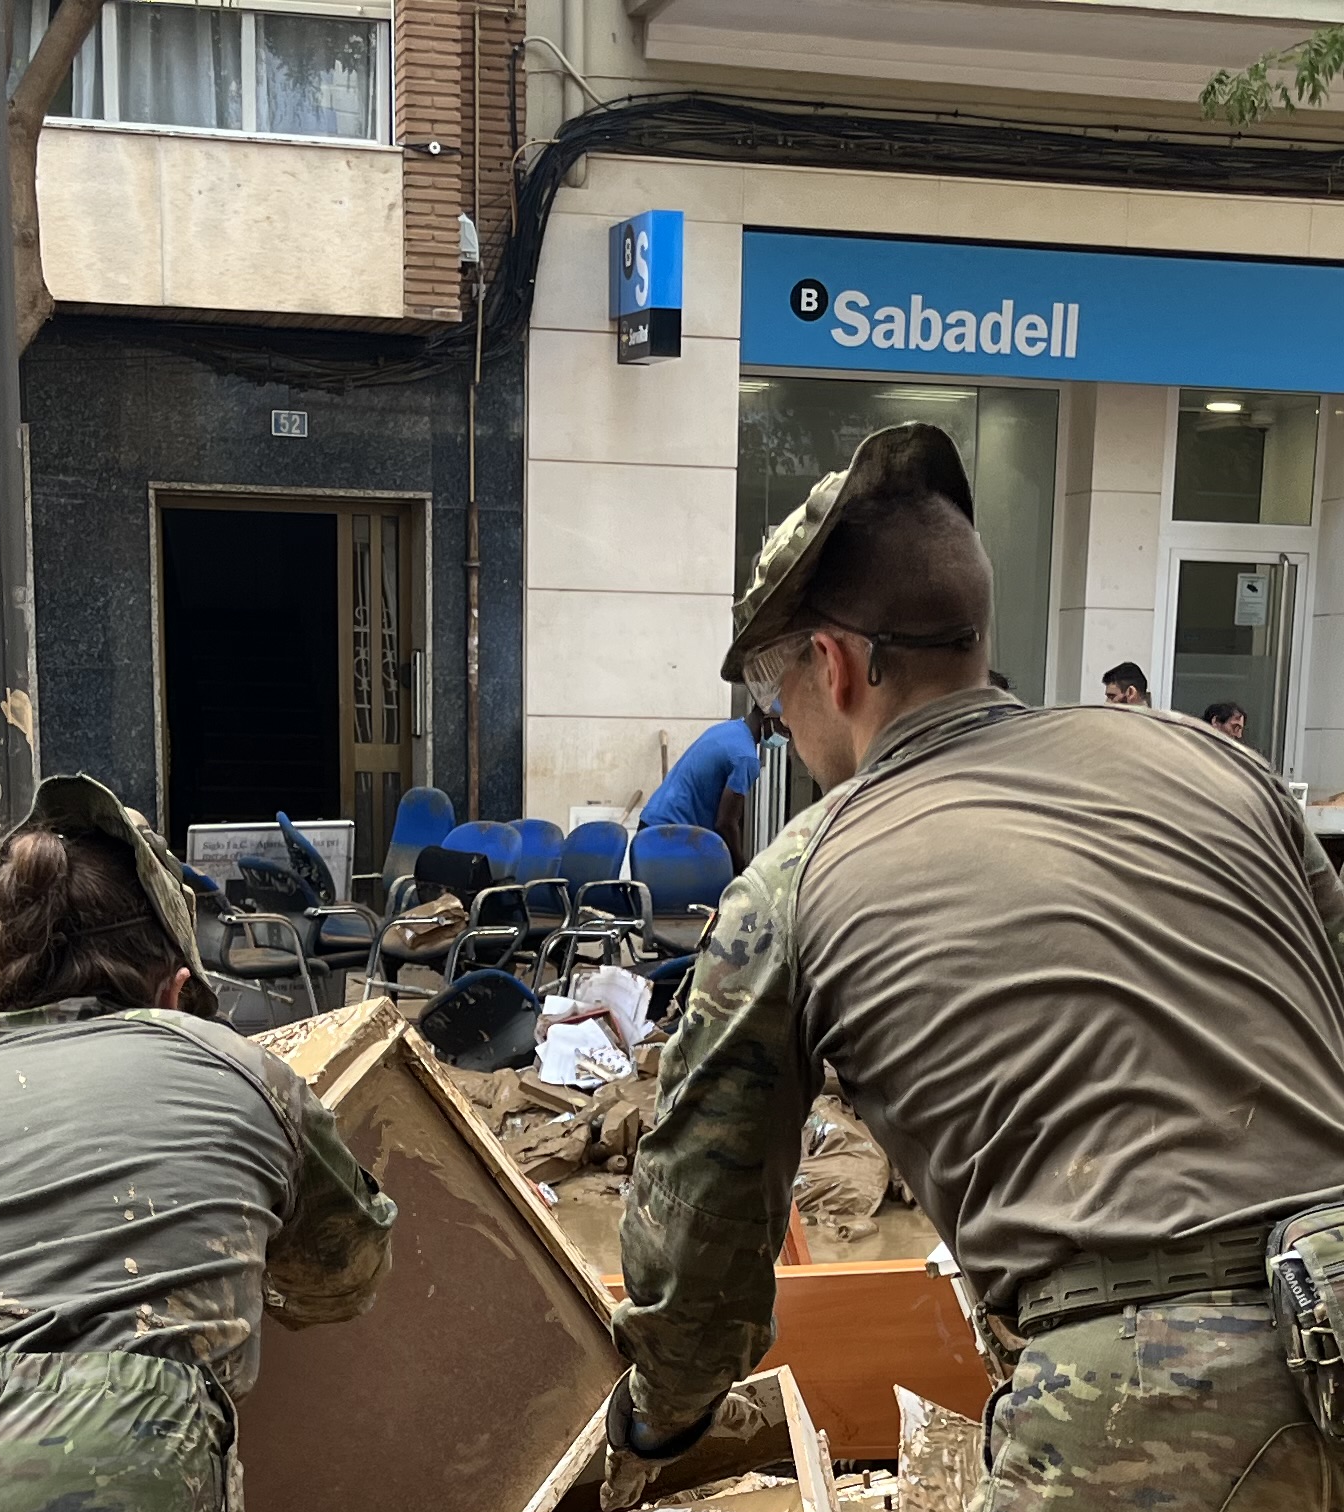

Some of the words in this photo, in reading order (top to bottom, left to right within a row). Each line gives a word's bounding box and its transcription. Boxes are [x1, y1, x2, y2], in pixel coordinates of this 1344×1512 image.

[635, 230, 649, 307] S
[801, 287, 818, 311] B
[830, 290, 1079, 358] Sabadell
[280, 413, 301, 433] 52
